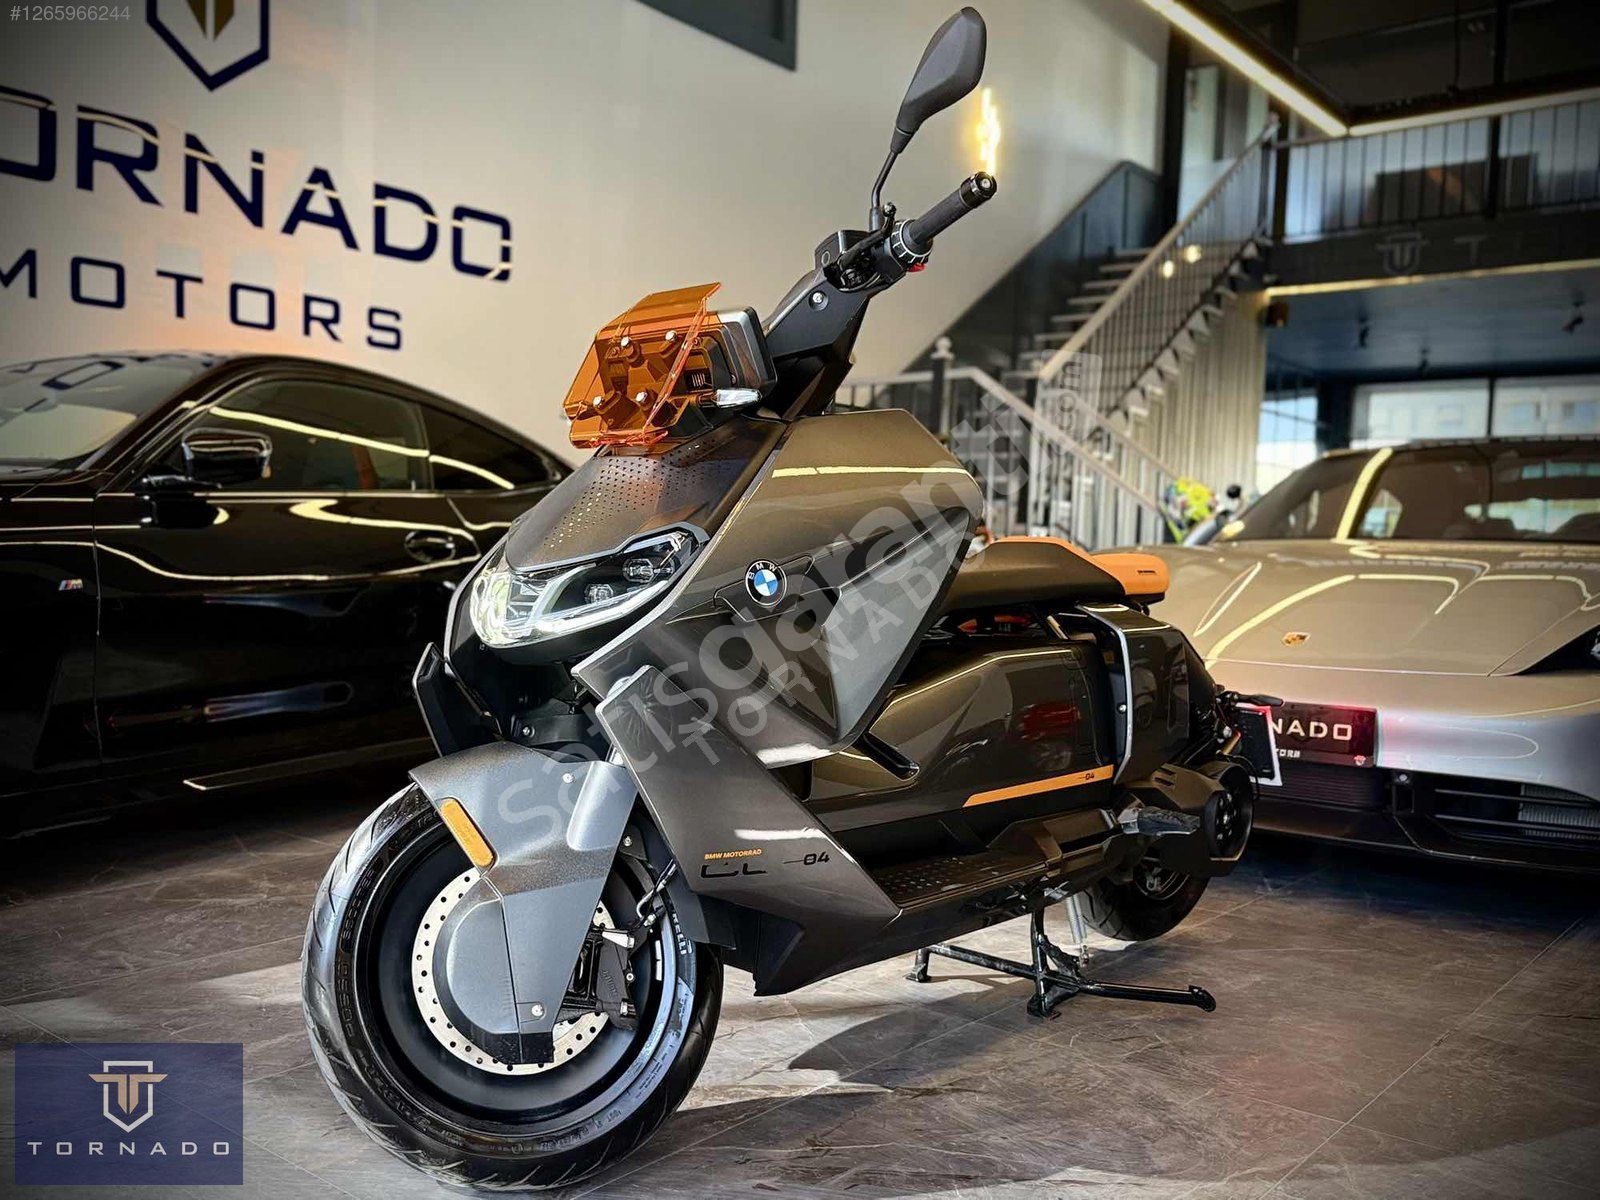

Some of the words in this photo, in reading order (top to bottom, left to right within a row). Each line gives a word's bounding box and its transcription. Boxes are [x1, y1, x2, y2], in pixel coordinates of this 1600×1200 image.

[0, 84, 512, 282] ORNADO
[747, 562, 778, 581] BMW
[1271, 718, 1353, 742] NADO
[704, 851, 723, 860] BMW
[723, 848, 762, 859] MOTORRAD
[672, 911, 693, 955] RELLI
